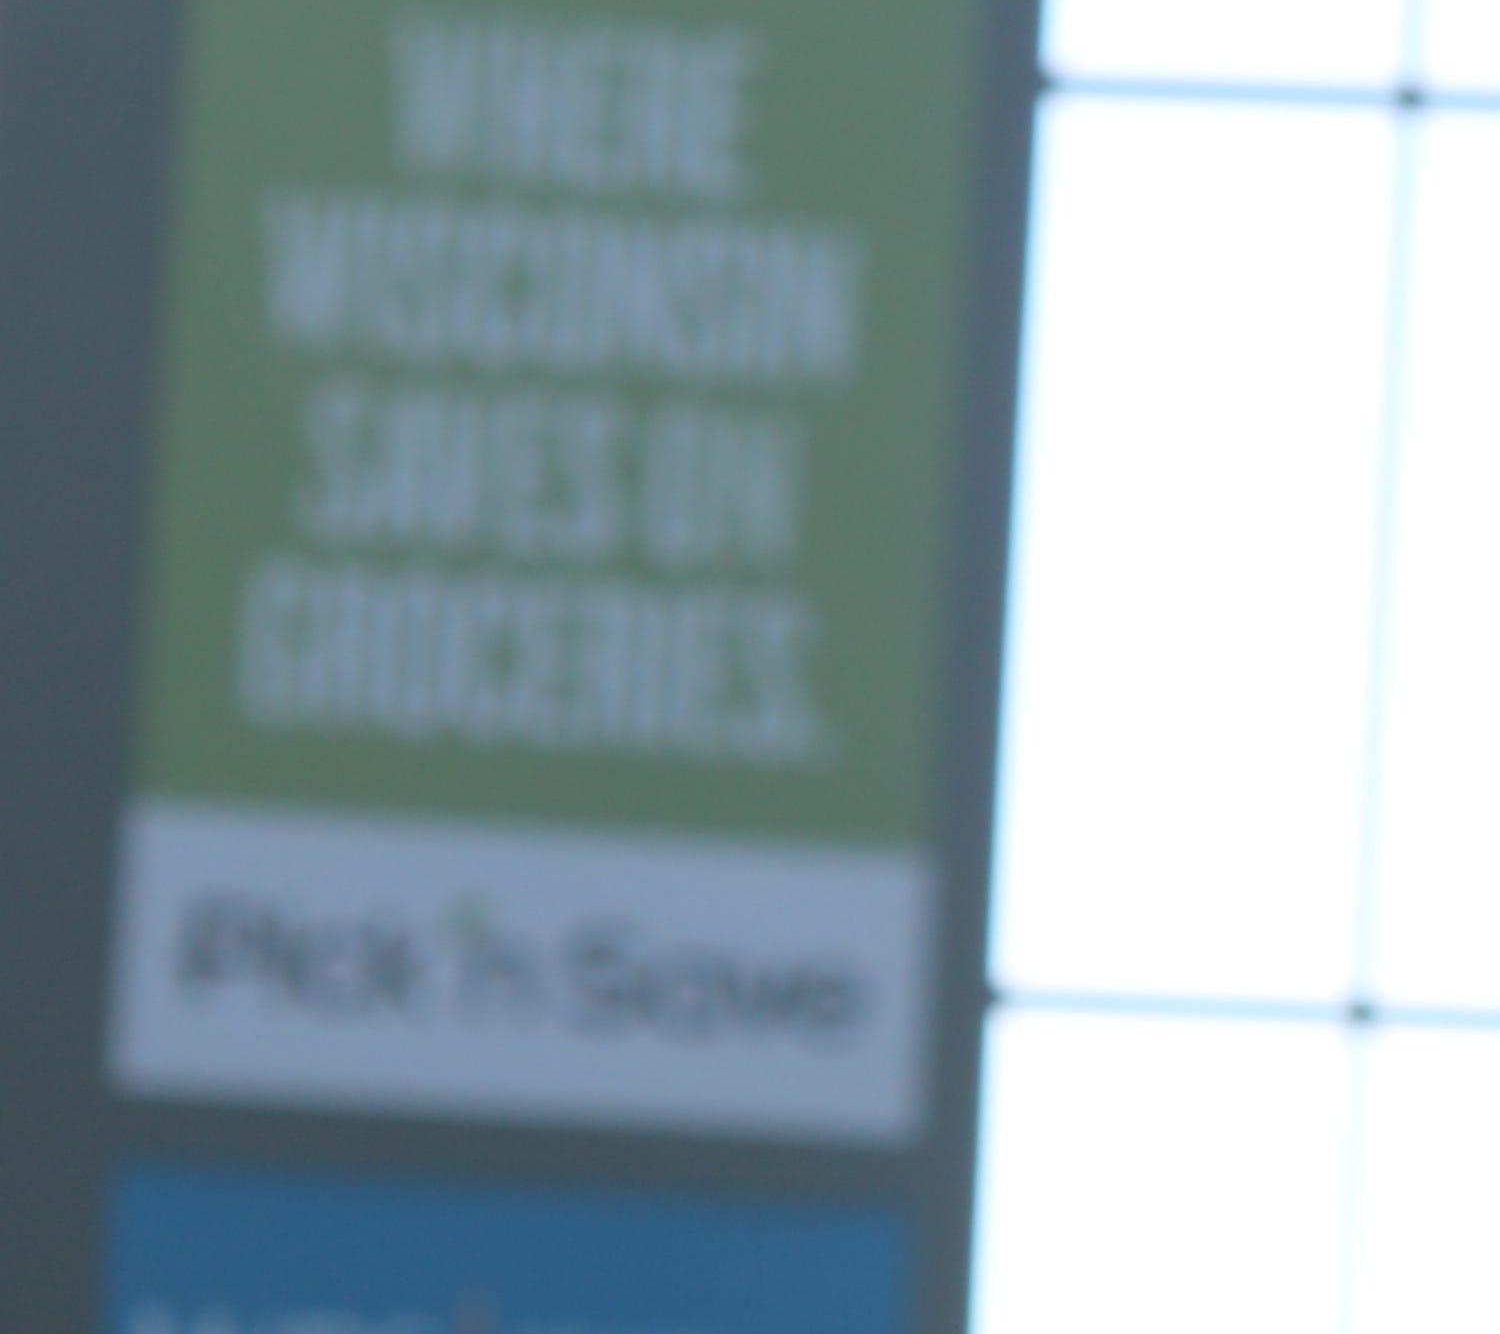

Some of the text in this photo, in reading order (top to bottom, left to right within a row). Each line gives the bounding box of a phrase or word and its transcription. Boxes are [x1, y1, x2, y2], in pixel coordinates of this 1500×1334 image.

[391, 12, 758, 203] WHERE
[258, 189, 866, 394] WISCONSIN
[296, 373, 806, 570] SAVES ON
[176, 889, 424, 1021] Pick
[564, 921, 870, 1053] Save
